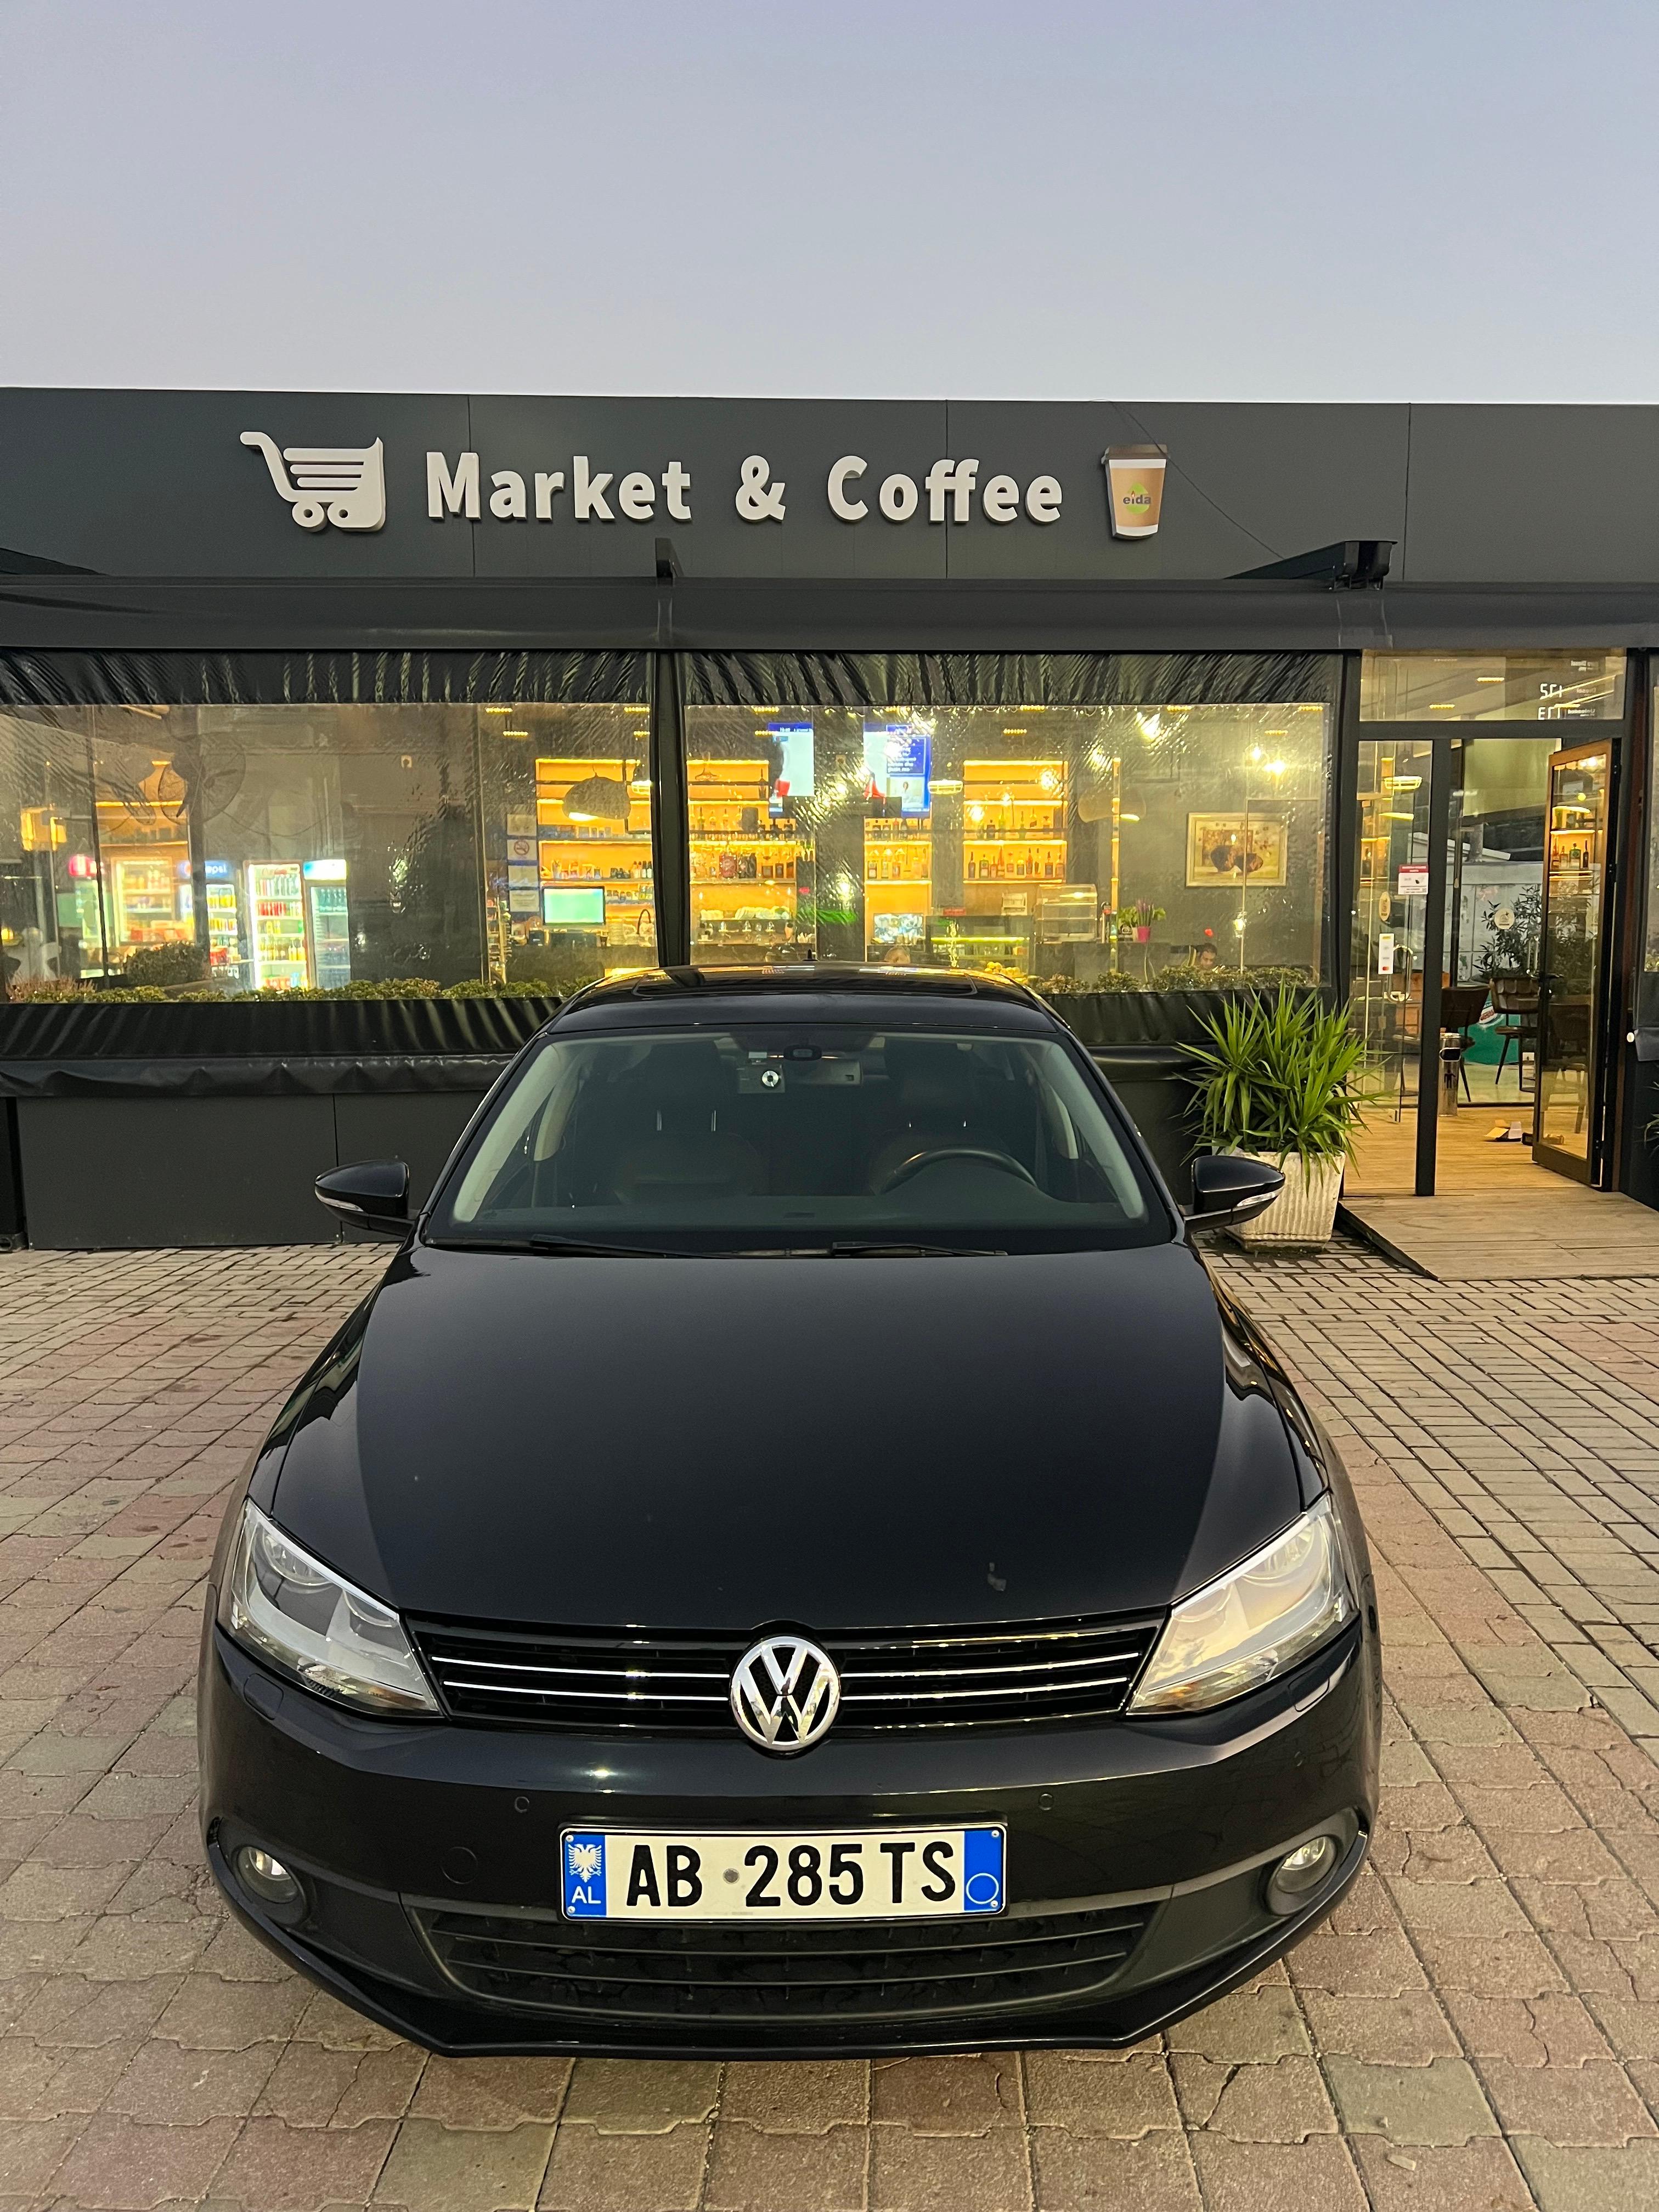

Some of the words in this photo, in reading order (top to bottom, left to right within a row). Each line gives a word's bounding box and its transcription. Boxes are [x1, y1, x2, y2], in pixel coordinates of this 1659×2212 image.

[426, 452, 691, 521] Market
[735, 455, 786, 523] &
[827, 455, 1063, 524] Coffee
[1123, 493, 1151, 504] eida
[627, 1844, 702, 1907] AB
[744, 1844, 863, 1907] 285
[881, 1841, 956, 1904] TS
[572, 1887, 601, 1905] AL
